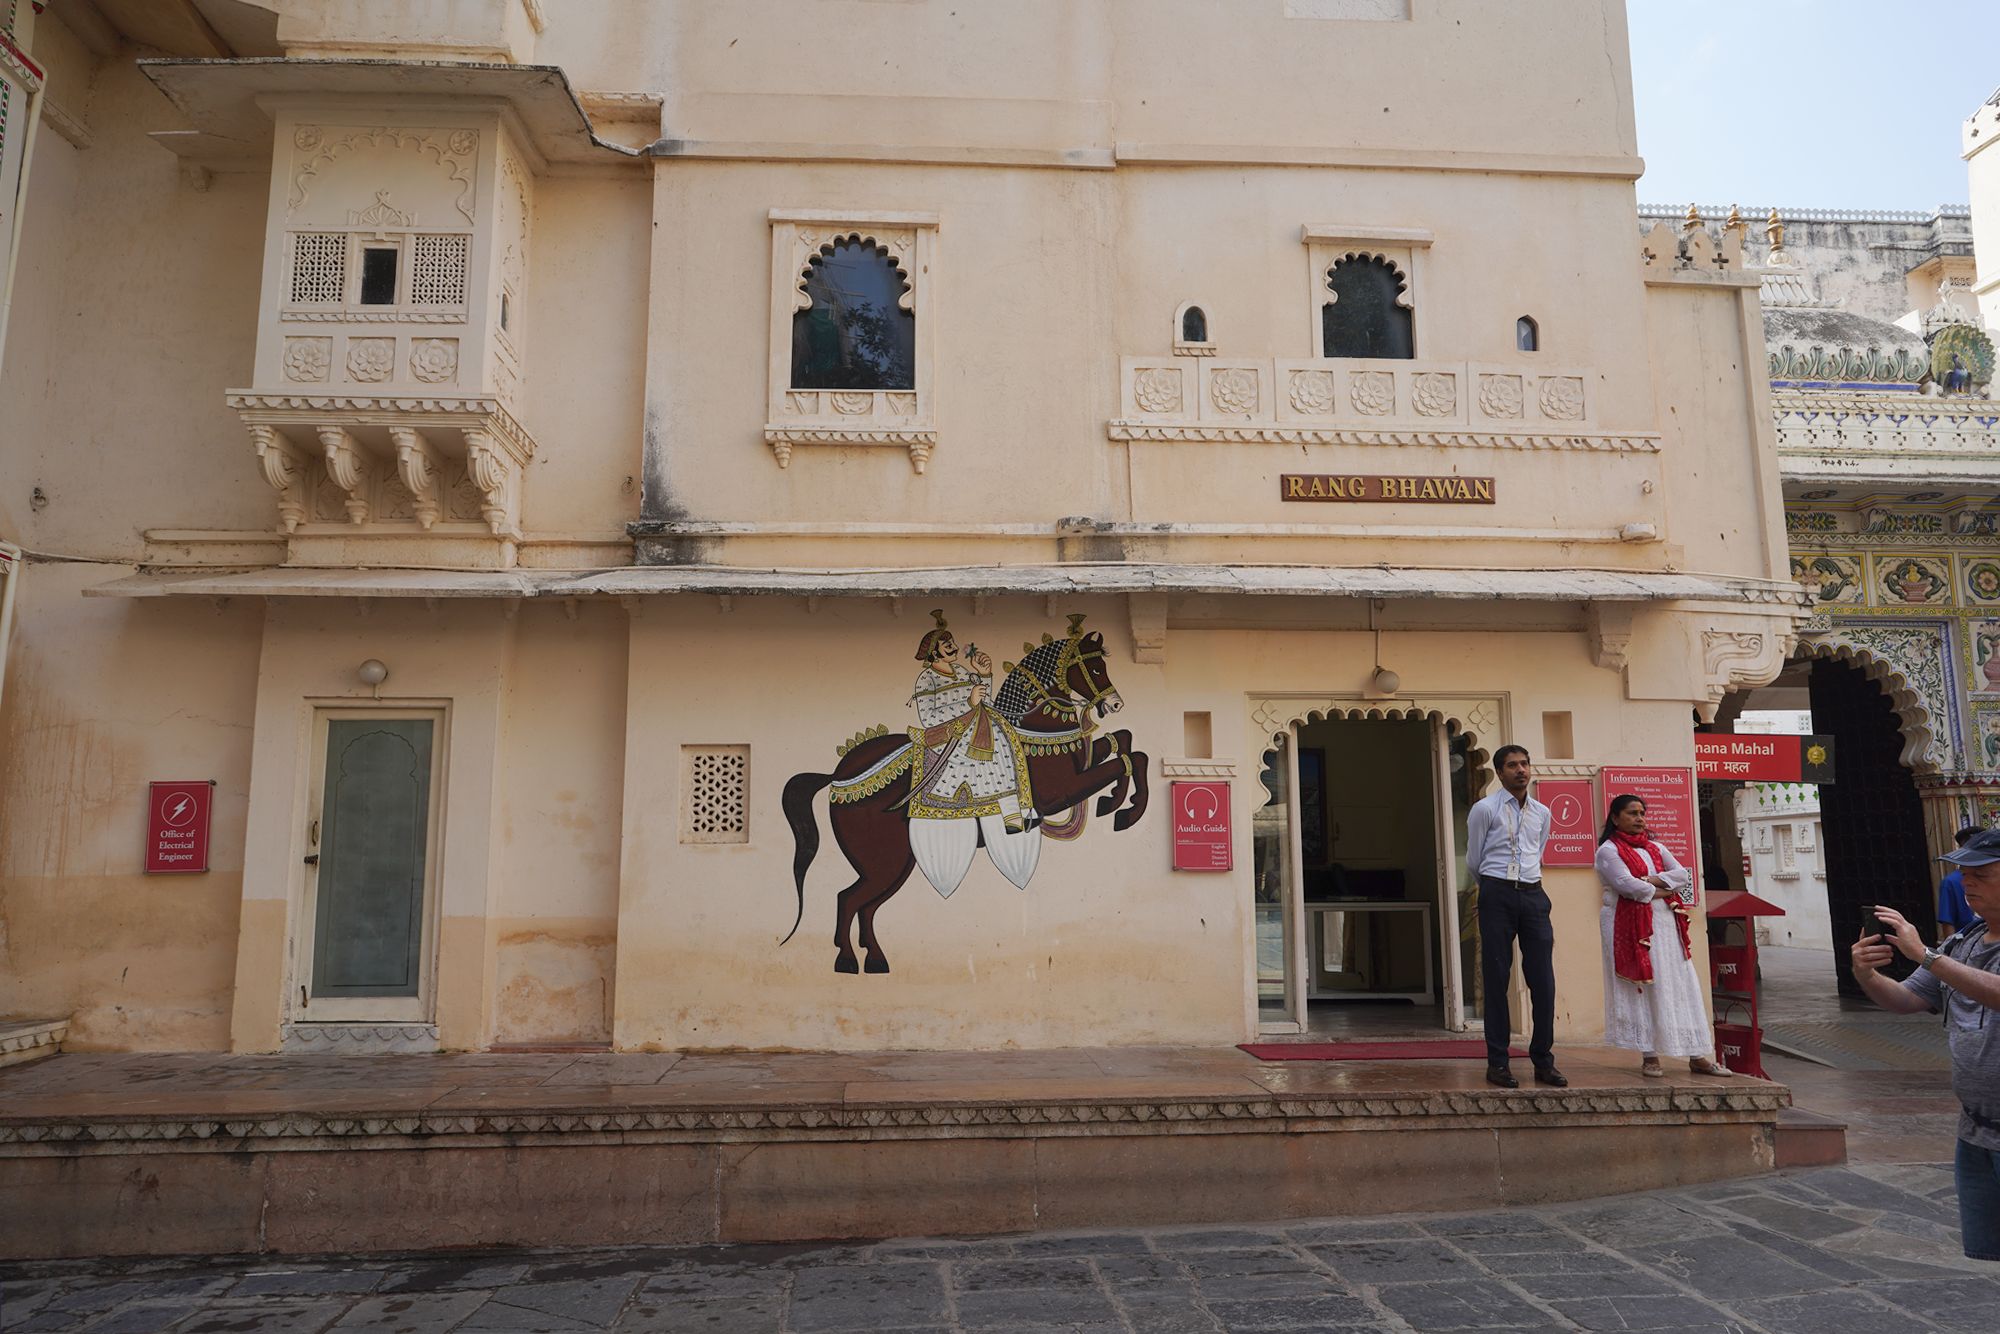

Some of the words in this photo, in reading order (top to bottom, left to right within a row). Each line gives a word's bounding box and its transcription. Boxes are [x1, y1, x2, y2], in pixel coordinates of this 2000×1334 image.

[1287, 476, 1366, 498] RANG
[1379, 477, 1492, 500] BHAWAN
[1695, 743, 1727, 754] nana
[1731, 743, 1774, 755] Mahal
[1722, 761, 1750, 774] महल
[1610, 773, 1660, 783] Information
[1662, 774, 1684, 783] Desk
[1177, 824, 1201, 832] Audio
[1202, 824, 1227, 832] Guide
[160, 830, 185, 838] Office
[185, 829, 196, 838] of
[1546, 831, 1592, 840] nformation
[159, 841, 194, 849] Electrical
[1554, 843, 1583, 852] Centre
[159, 852, 193, 863] Engineer
